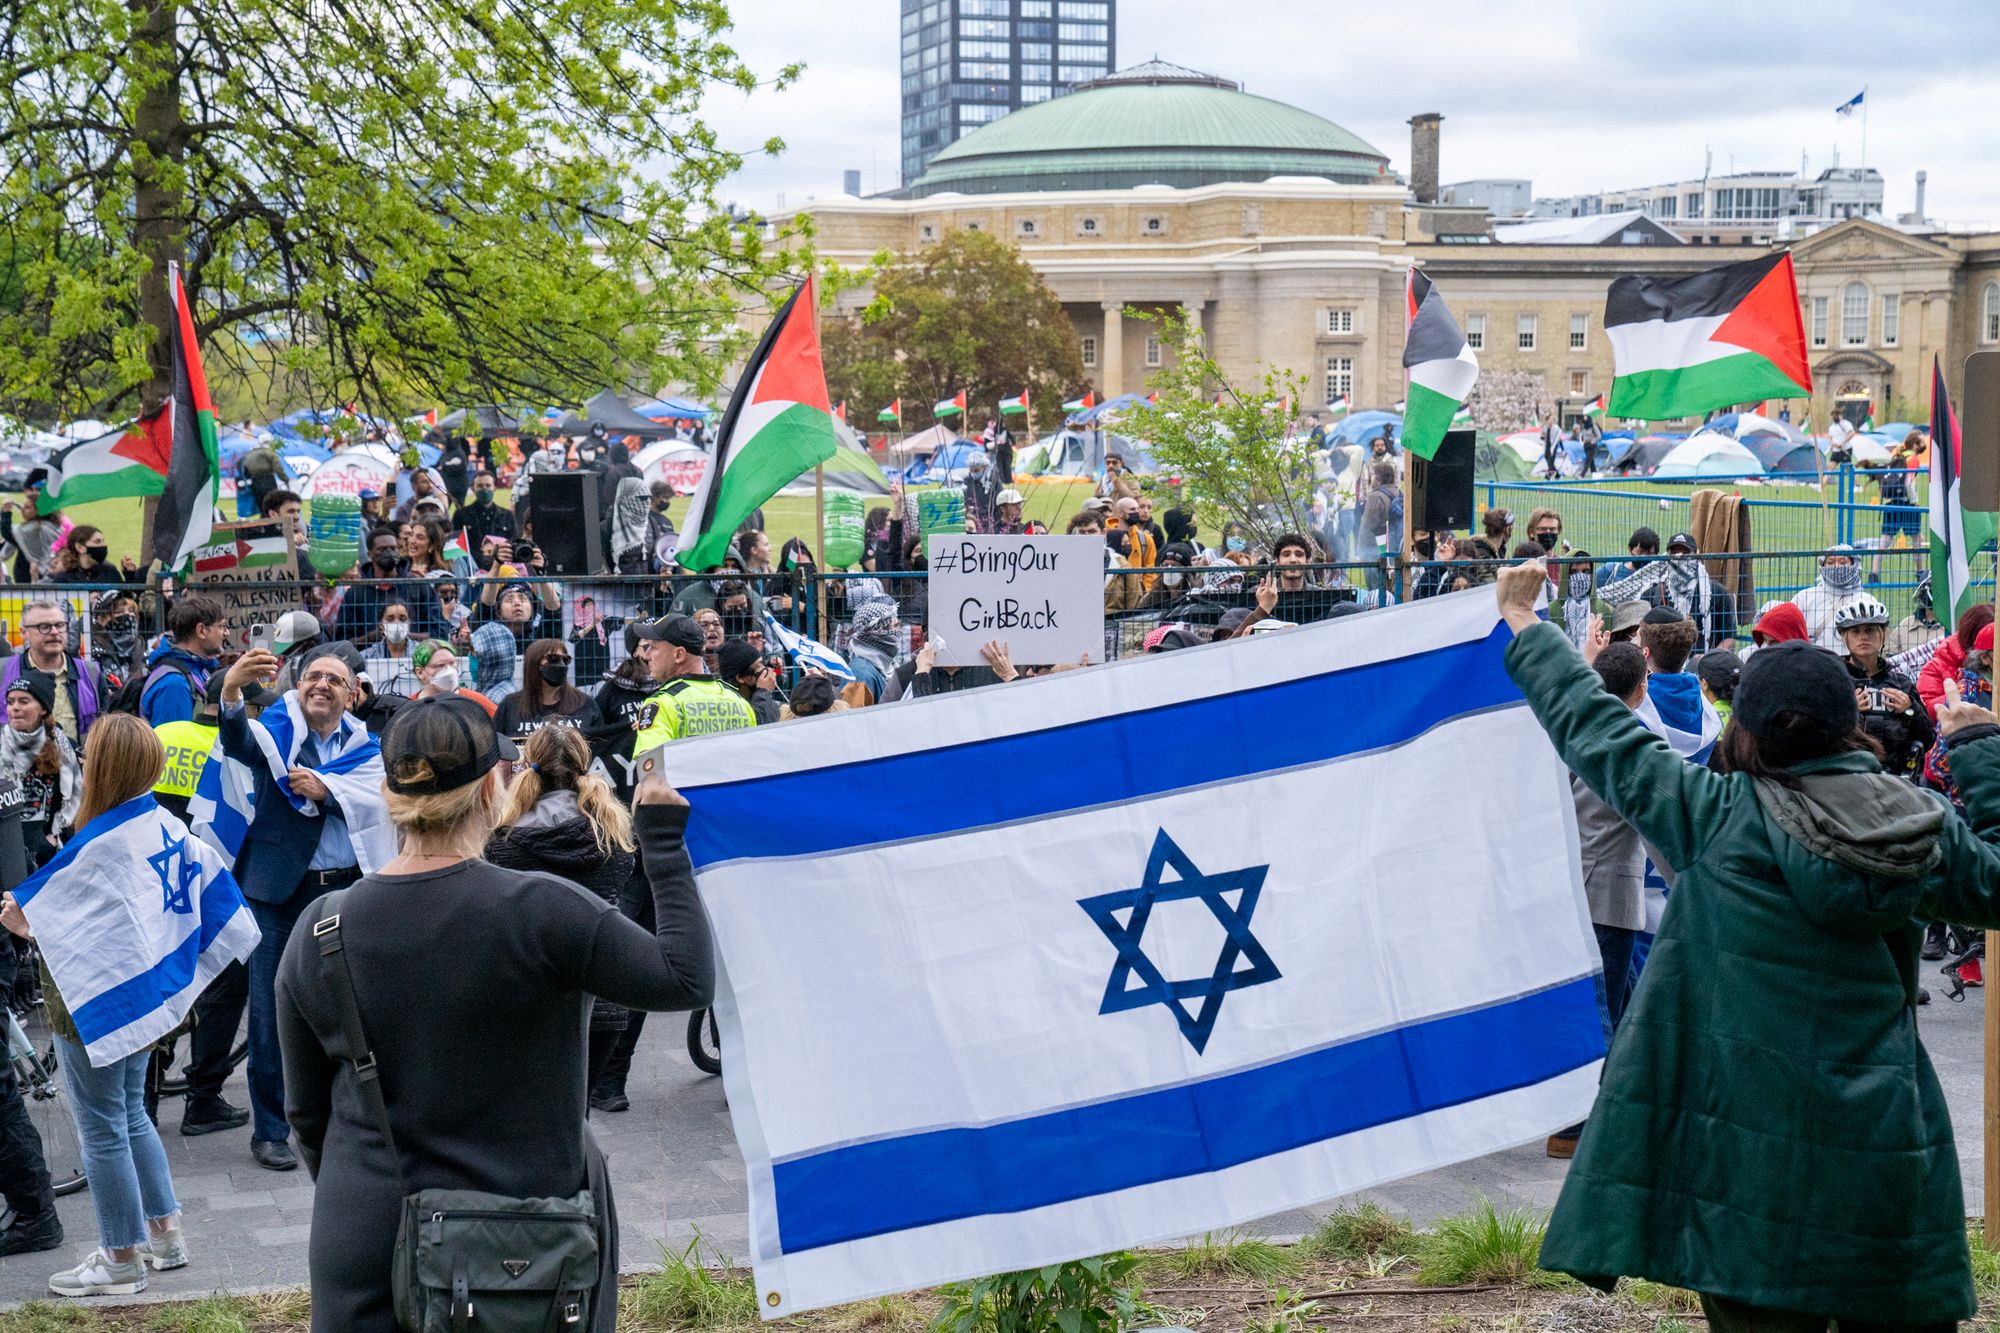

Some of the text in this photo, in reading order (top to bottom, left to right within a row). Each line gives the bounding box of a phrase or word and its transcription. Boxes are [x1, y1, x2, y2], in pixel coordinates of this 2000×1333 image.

[933, 542, 1059, 583] #BringOur
[257, 568, 295, 581] IRAN
[224, 587, 299, 609] PALESTINE
[685, 702, 748, 717] SPECIAL
[688, 718, 748, 734] CONSTABLE
